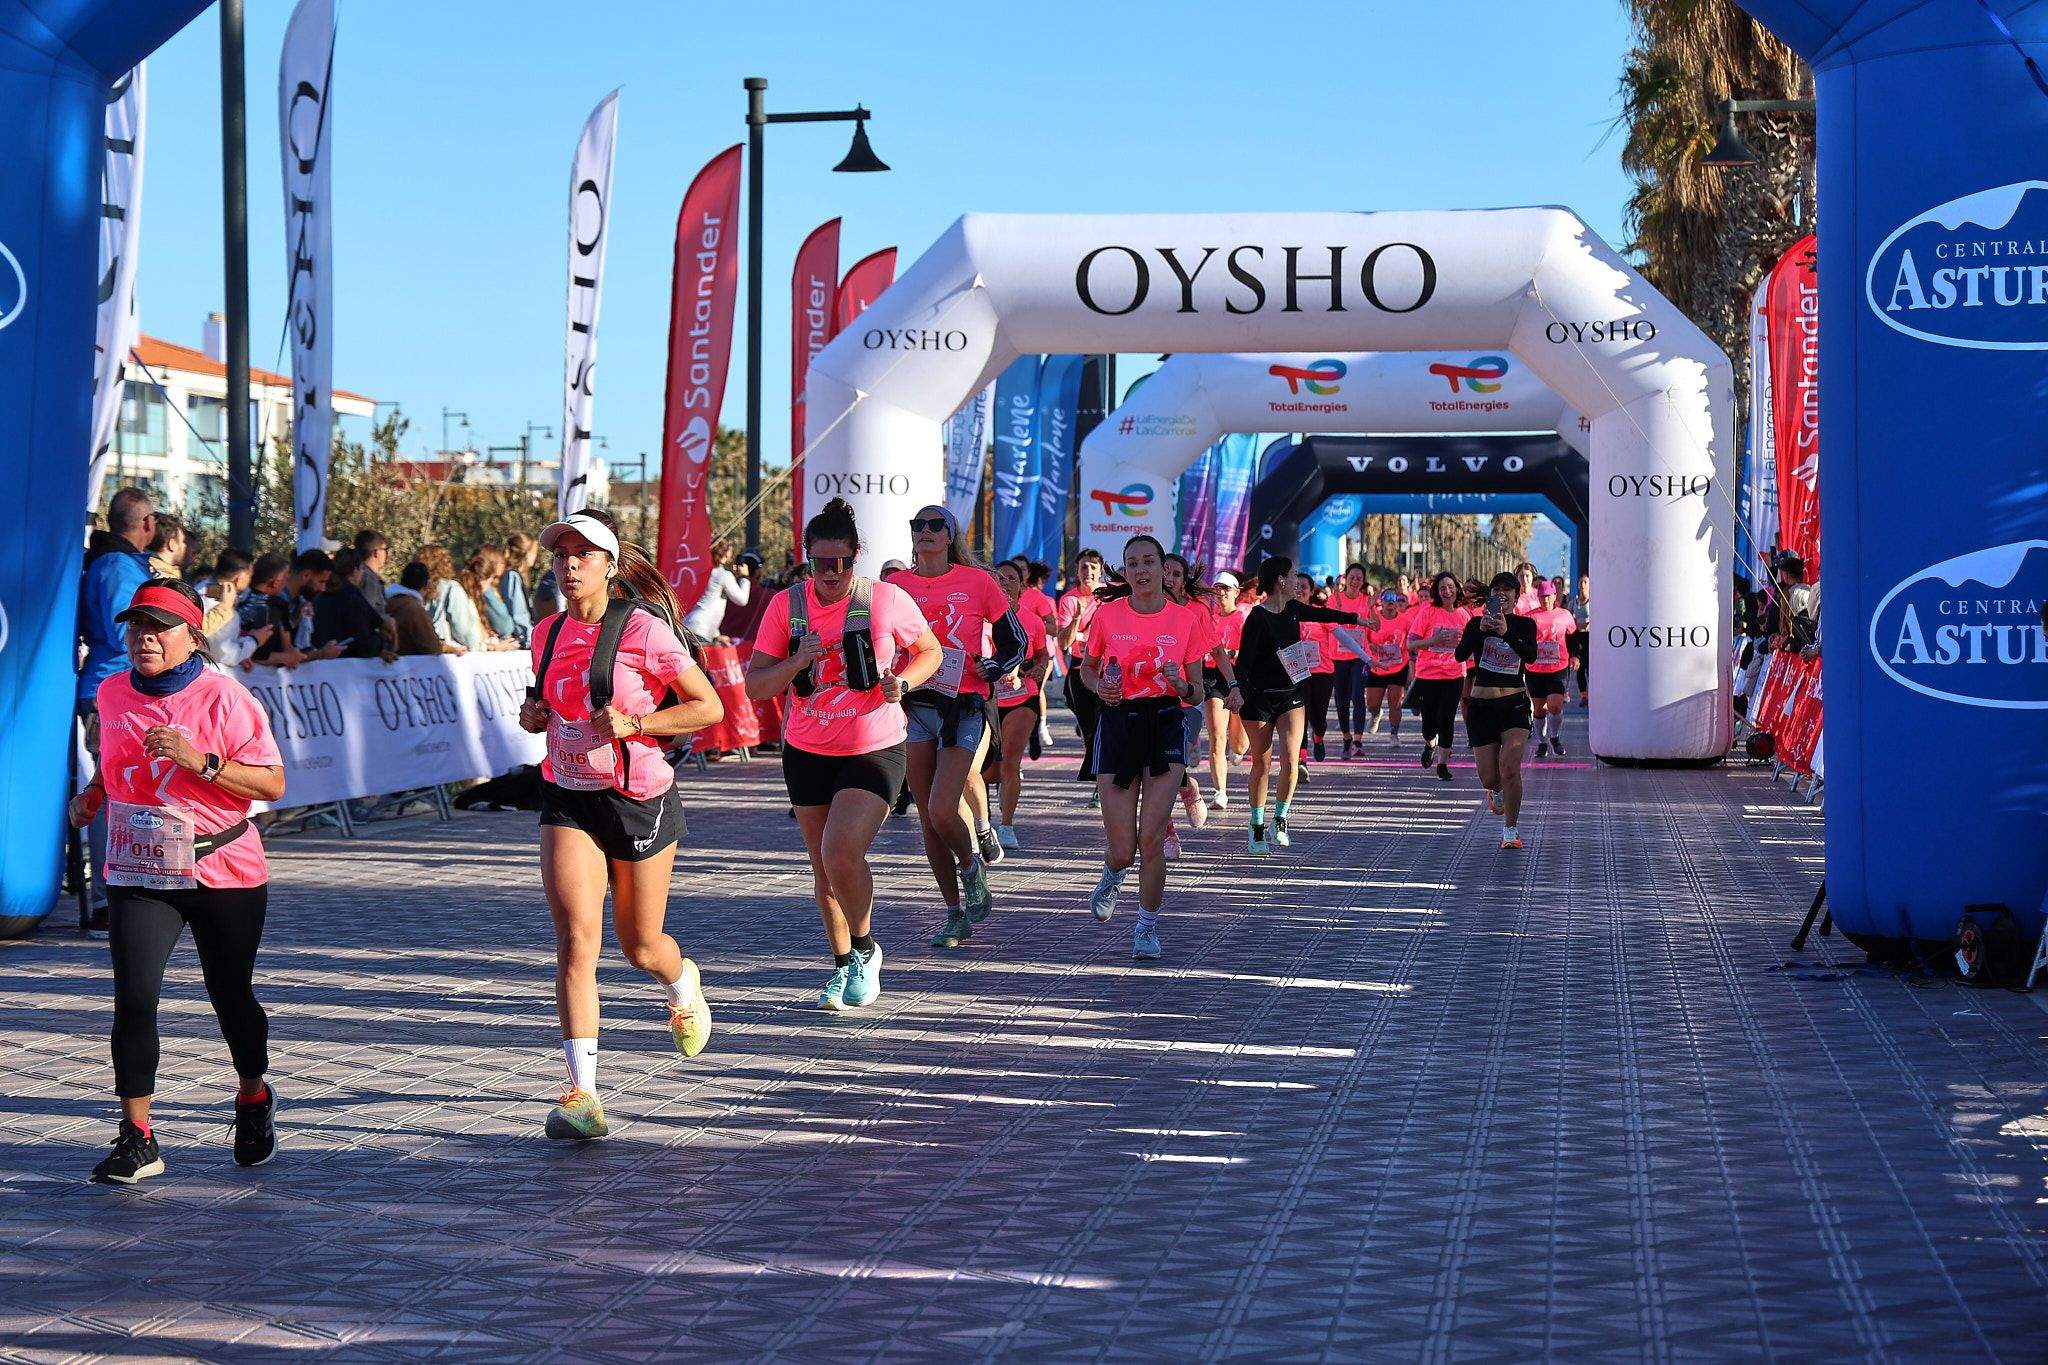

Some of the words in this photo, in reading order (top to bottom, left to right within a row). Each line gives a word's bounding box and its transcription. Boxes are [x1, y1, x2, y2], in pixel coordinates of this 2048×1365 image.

[1935, 240, 2048, 259] CENTRAL
[1075, 242, 1437, 315] OYSHO
[684, 211, 721, 408] Santander
[863, 328, 968, 352] OYSHO
[1545, 320, 1656, 344] OYSHO
[1269, 402, 1348, 414] TotalEnergies
[1429, 399, 1509, 412] TotalEnergies
[996, 394, 1041, 508] Marlene
[1347, 456, 1524, 473] VOLVO
[814, 472, 910, 497] OYSHO
[1608, 474, 1711, 498] OYSHO
[1090, 522, 1153, 534] TotalEnergies
[1939, 599, 2048, 615] CENTRA
[1608, 625, 1710, 648] OYSHO
[374, 674, 459, 731] OYSHO
[560, 749, 587, 765] 016
[132, 843, 164, 858] 016
